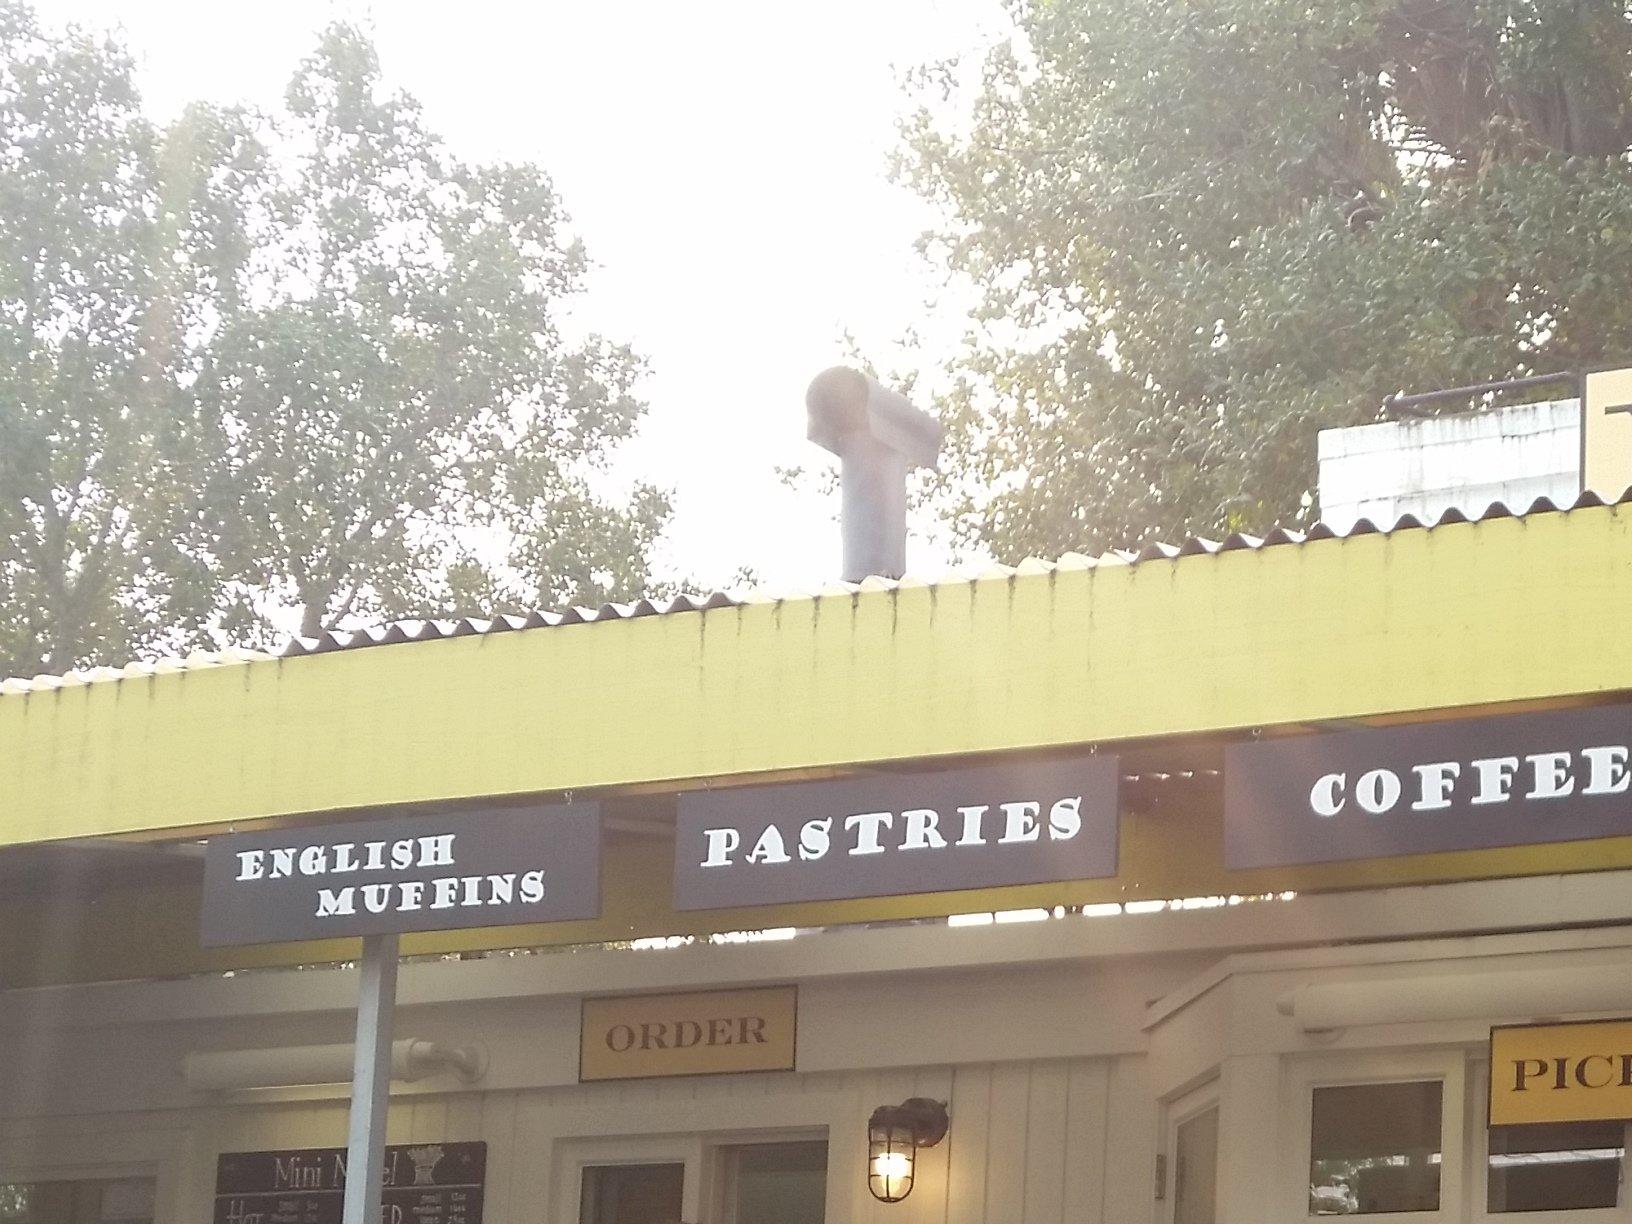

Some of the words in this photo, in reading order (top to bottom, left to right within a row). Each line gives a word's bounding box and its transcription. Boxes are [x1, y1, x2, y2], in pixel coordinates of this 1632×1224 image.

[1310, 745, 1632, 816] COFFEE
[701, 796, 1082, 867] PASTRIES
[235, 834, 455, 881] ENGLISH
[315, 870, 545, 917] MUFFINS
[605, 1016, 768, 1052] ORDER
[274, 1155, 321, 1188] Mini
